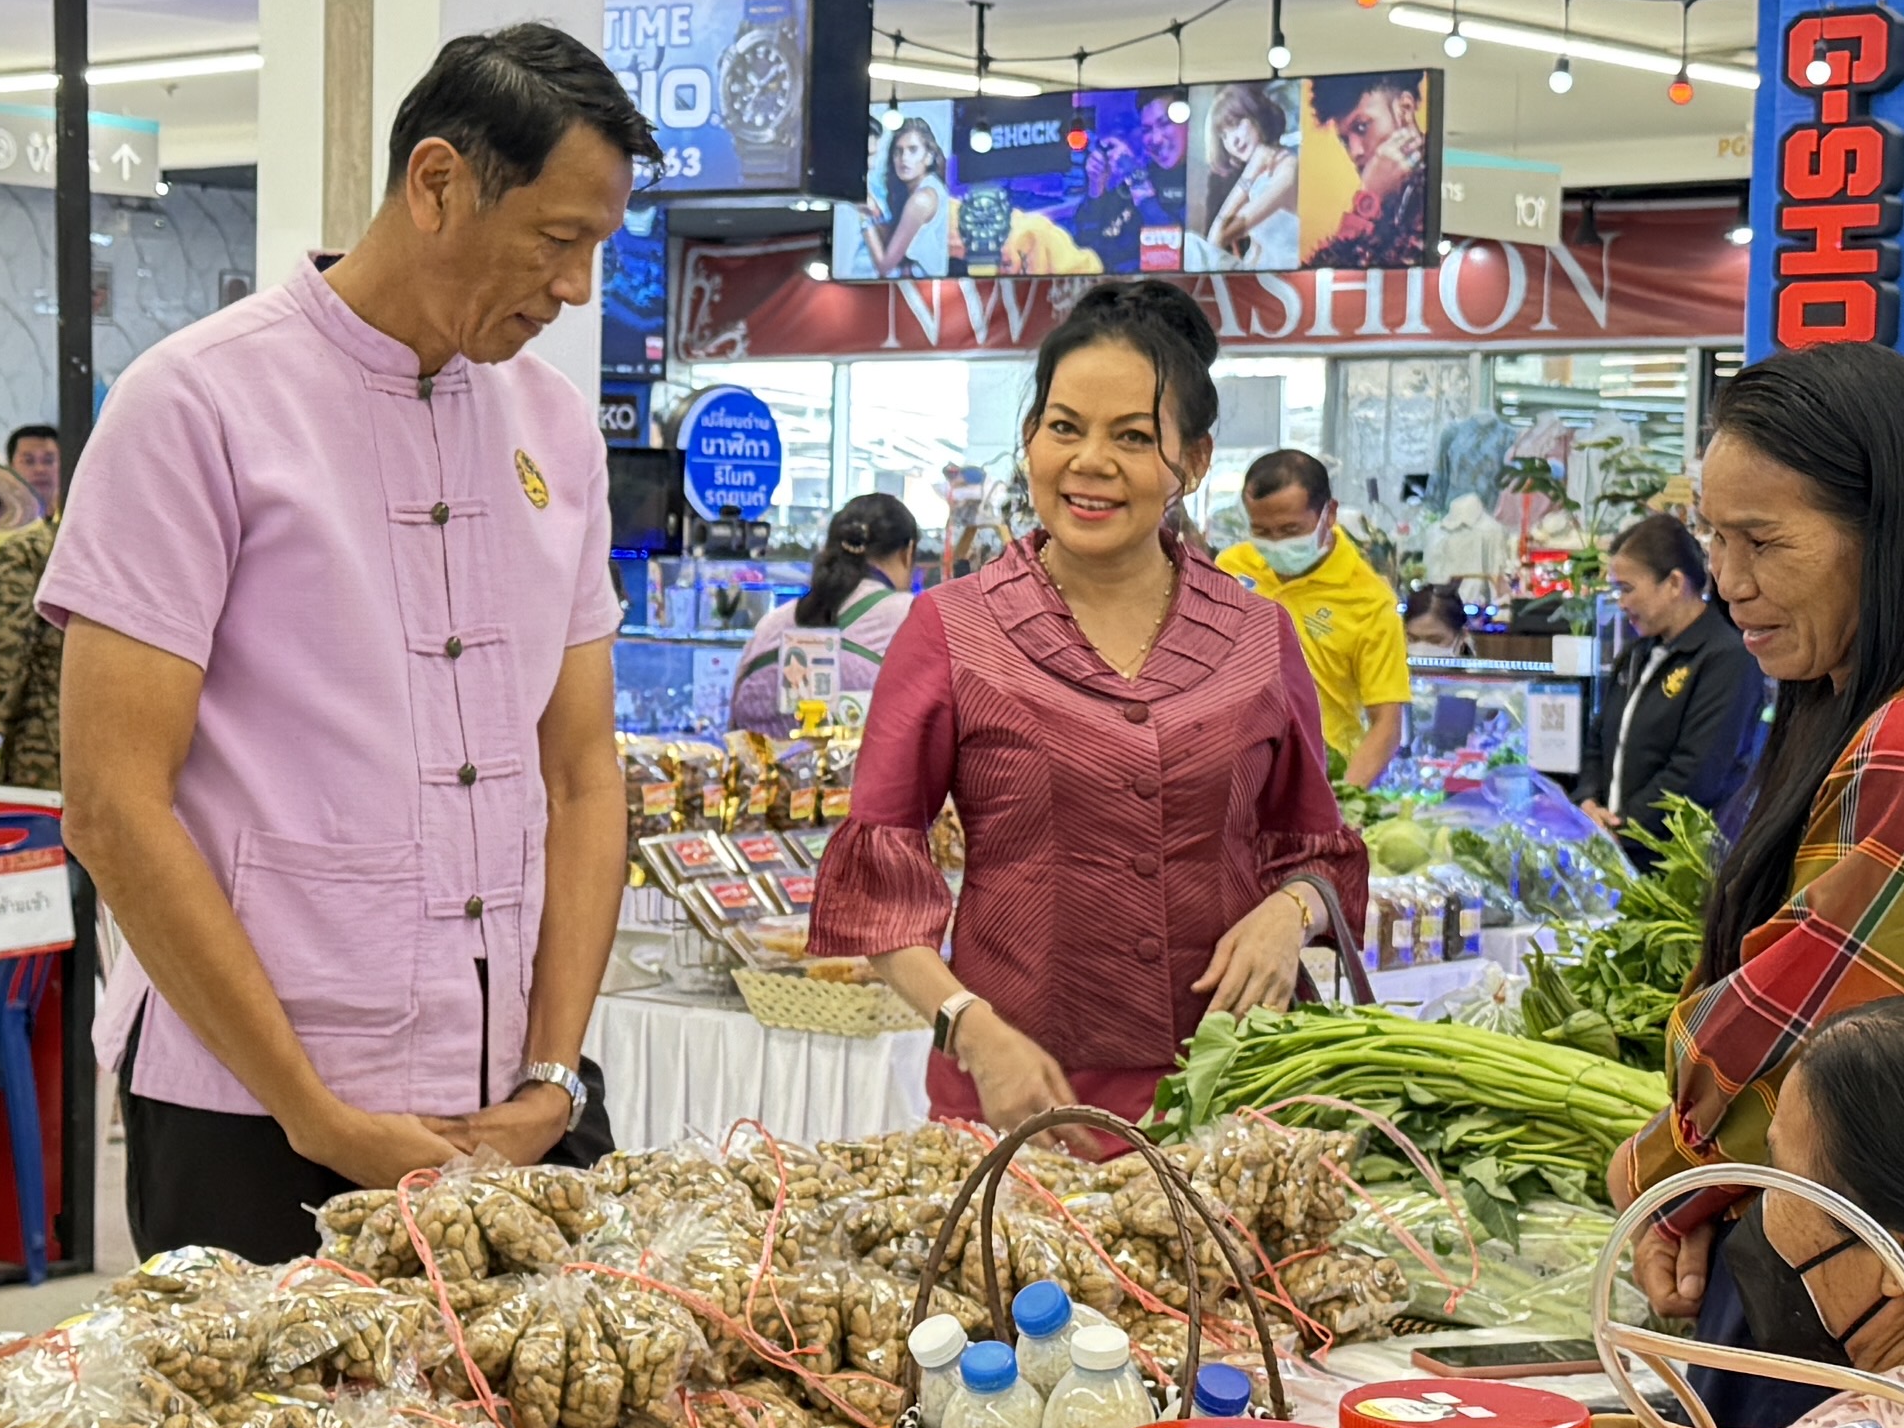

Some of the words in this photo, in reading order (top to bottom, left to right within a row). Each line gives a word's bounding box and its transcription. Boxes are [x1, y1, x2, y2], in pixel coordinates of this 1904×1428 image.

[603, 5, 694, 51] TIME
[990, 119, 1062, 150] SHOCK
[1717, 136, 1747, 158] PG
[1777, 12, 1889, 351] G-SHO
[1192, 230, 1622, 339] ASHION
[599, 402, 638, 431] KO
